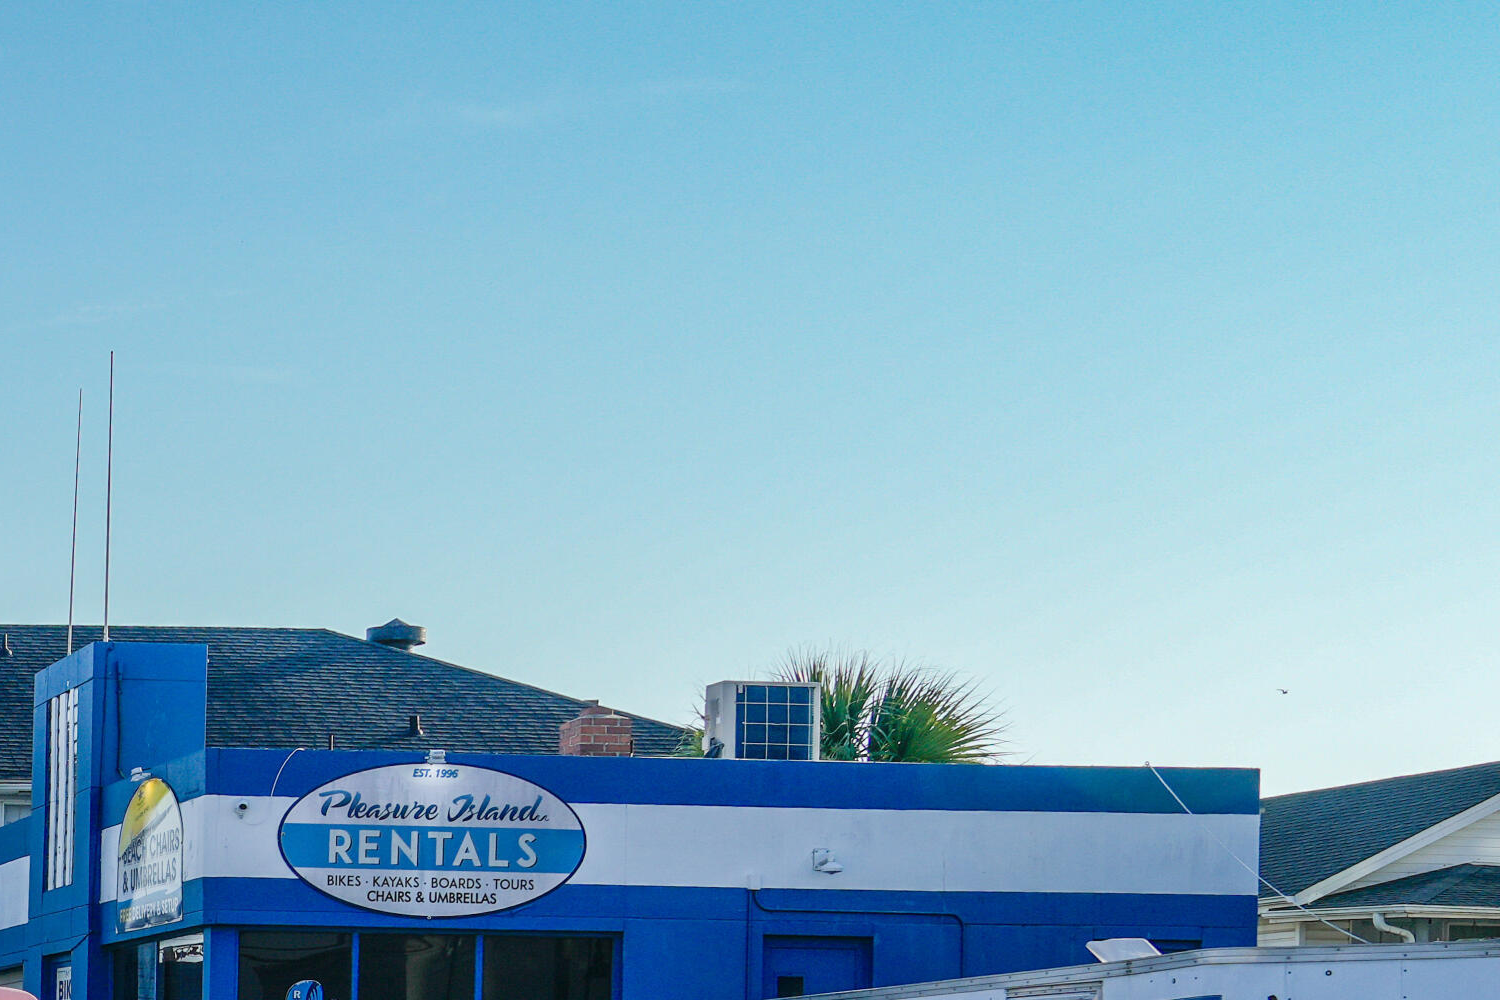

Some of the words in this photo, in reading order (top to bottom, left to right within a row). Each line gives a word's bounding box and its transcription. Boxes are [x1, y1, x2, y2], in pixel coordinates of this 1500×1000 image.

[412, 768, 432, 778] EST.
[436, 768, 459, 778] 1996
[319, 790, 439, 822] Pleasure
[448, 794, 543, 822] Island
[150, 828, 180, 857] CHAIRS
[328, 829, 539, 869] RENTALS
[123, 871, 129, 893] &
[130, 857, 177, 891] UMBRELLAS
[327, 875, 361, 887] BIKES
[373, 876, 419, 888] KAYAKS
[431, 877, 481, 890] BOARDS
[494, 879, 535, 891] TOURS
[367, 891, 411, 903] CHAIRS
[415, 892, 425, 903] &
[428, 892, 497, 904] UMBRELLAS
